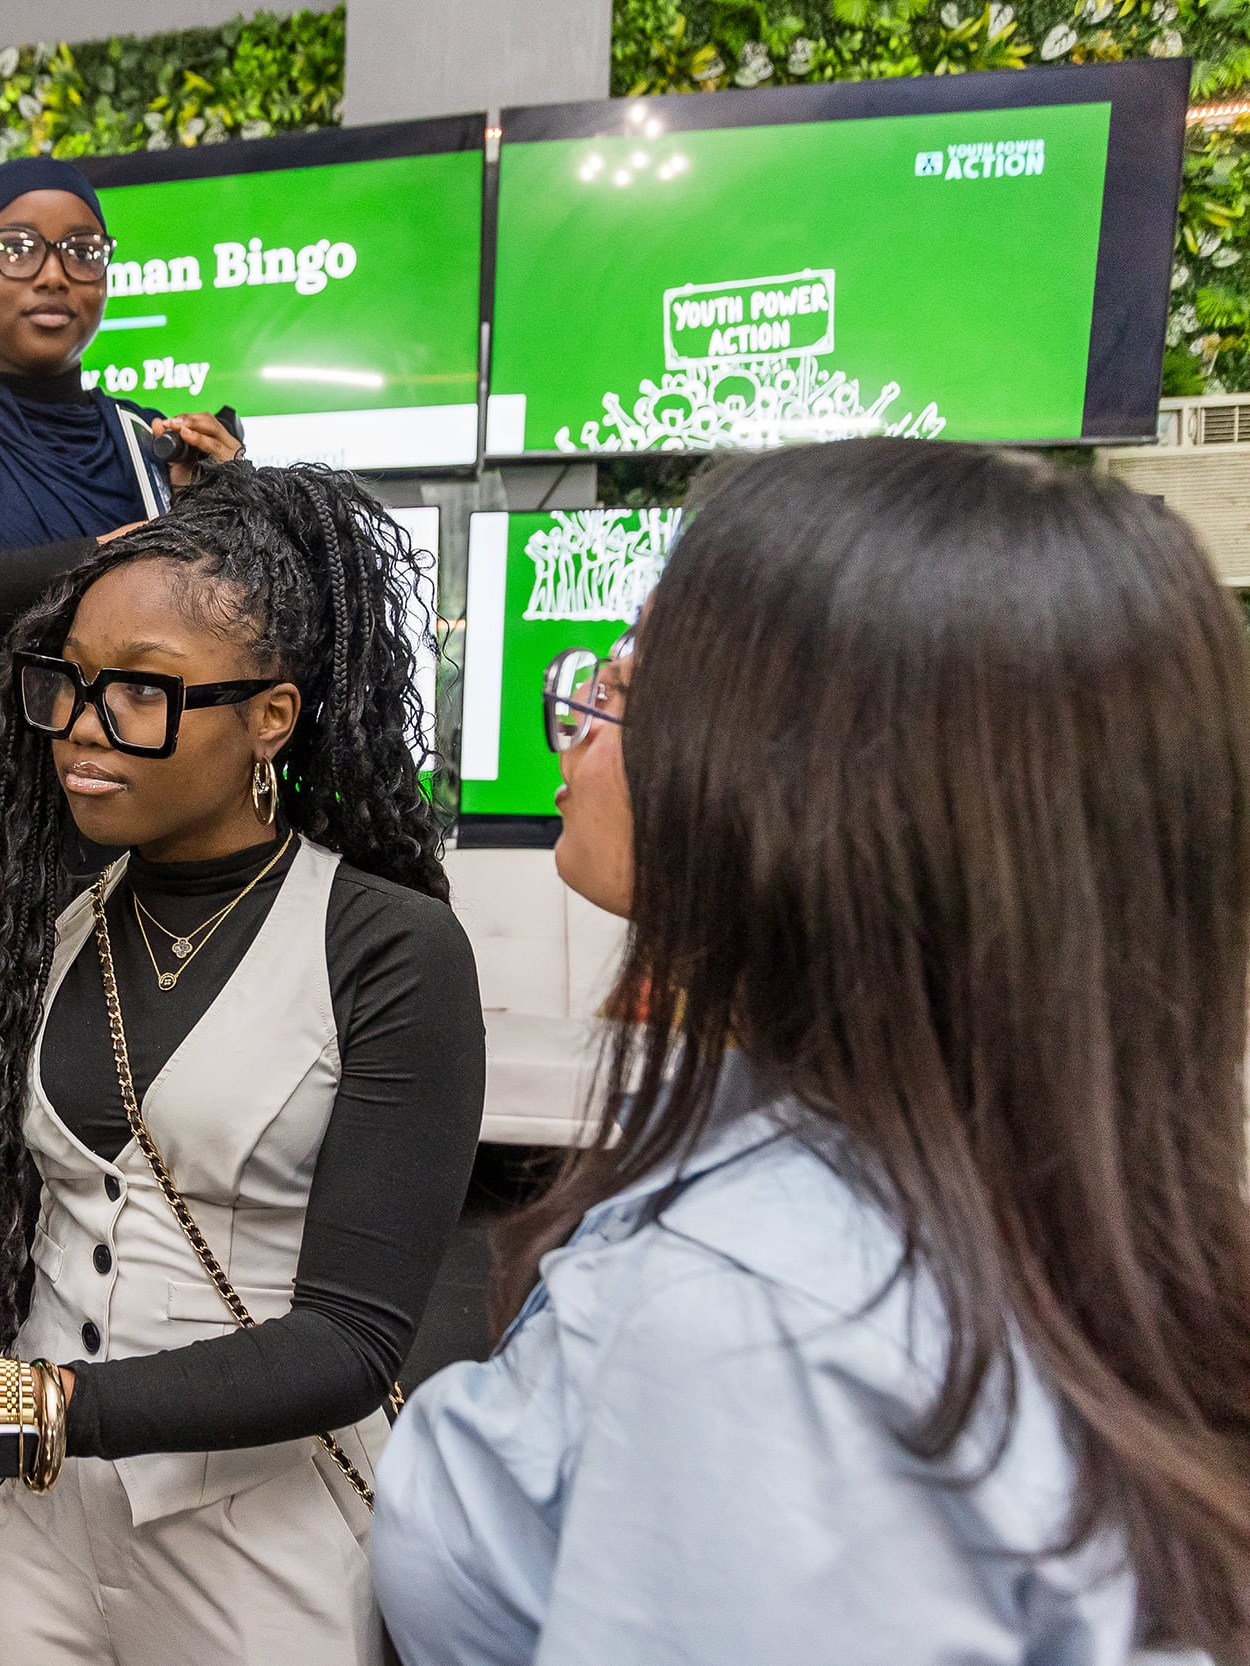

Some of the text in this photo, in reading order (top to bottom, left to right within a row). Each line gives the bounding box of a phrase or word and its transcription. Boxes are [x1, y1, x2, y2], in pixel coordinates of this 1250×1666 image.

[944, 151, 1045, 181] ACTION
[947, 139, 1045, 160] YOUTH POWER
[107, 237, 357, 297] man Bingo
[673, 283, 828, 331] YOUTH POWER
[708, 319, 790, 356] ACTION
[104, 364, 138, 392] to
[143, 356, 210, 396] Play
